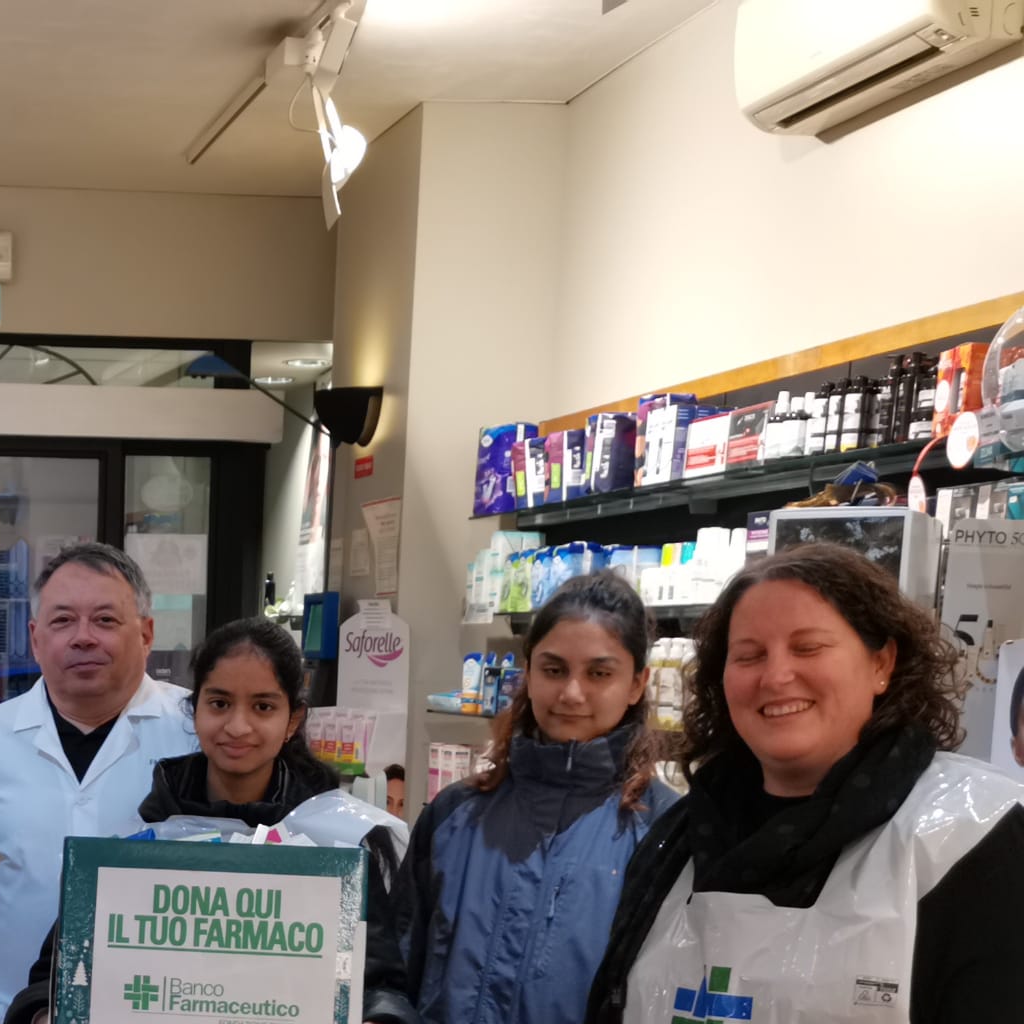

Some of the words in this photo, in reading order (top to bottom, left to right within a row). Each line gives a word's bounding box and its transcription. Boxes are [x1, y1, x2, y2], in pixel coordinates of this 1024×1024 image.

[954, 529, 1007, 545] PHYTO
[345, 629, 401, 659] Saforelle
[152, 883, 230, 917] DONA
[236, 888, 282, 919] QUI
[107, 913, 130, 944] IL
[134, 914, 188, 946] TUO
[193, 918, 324, 953] FARMACO
[169, 977, 225, 997] Banco
[169, 995, 300, 1017] Farmaceutico
